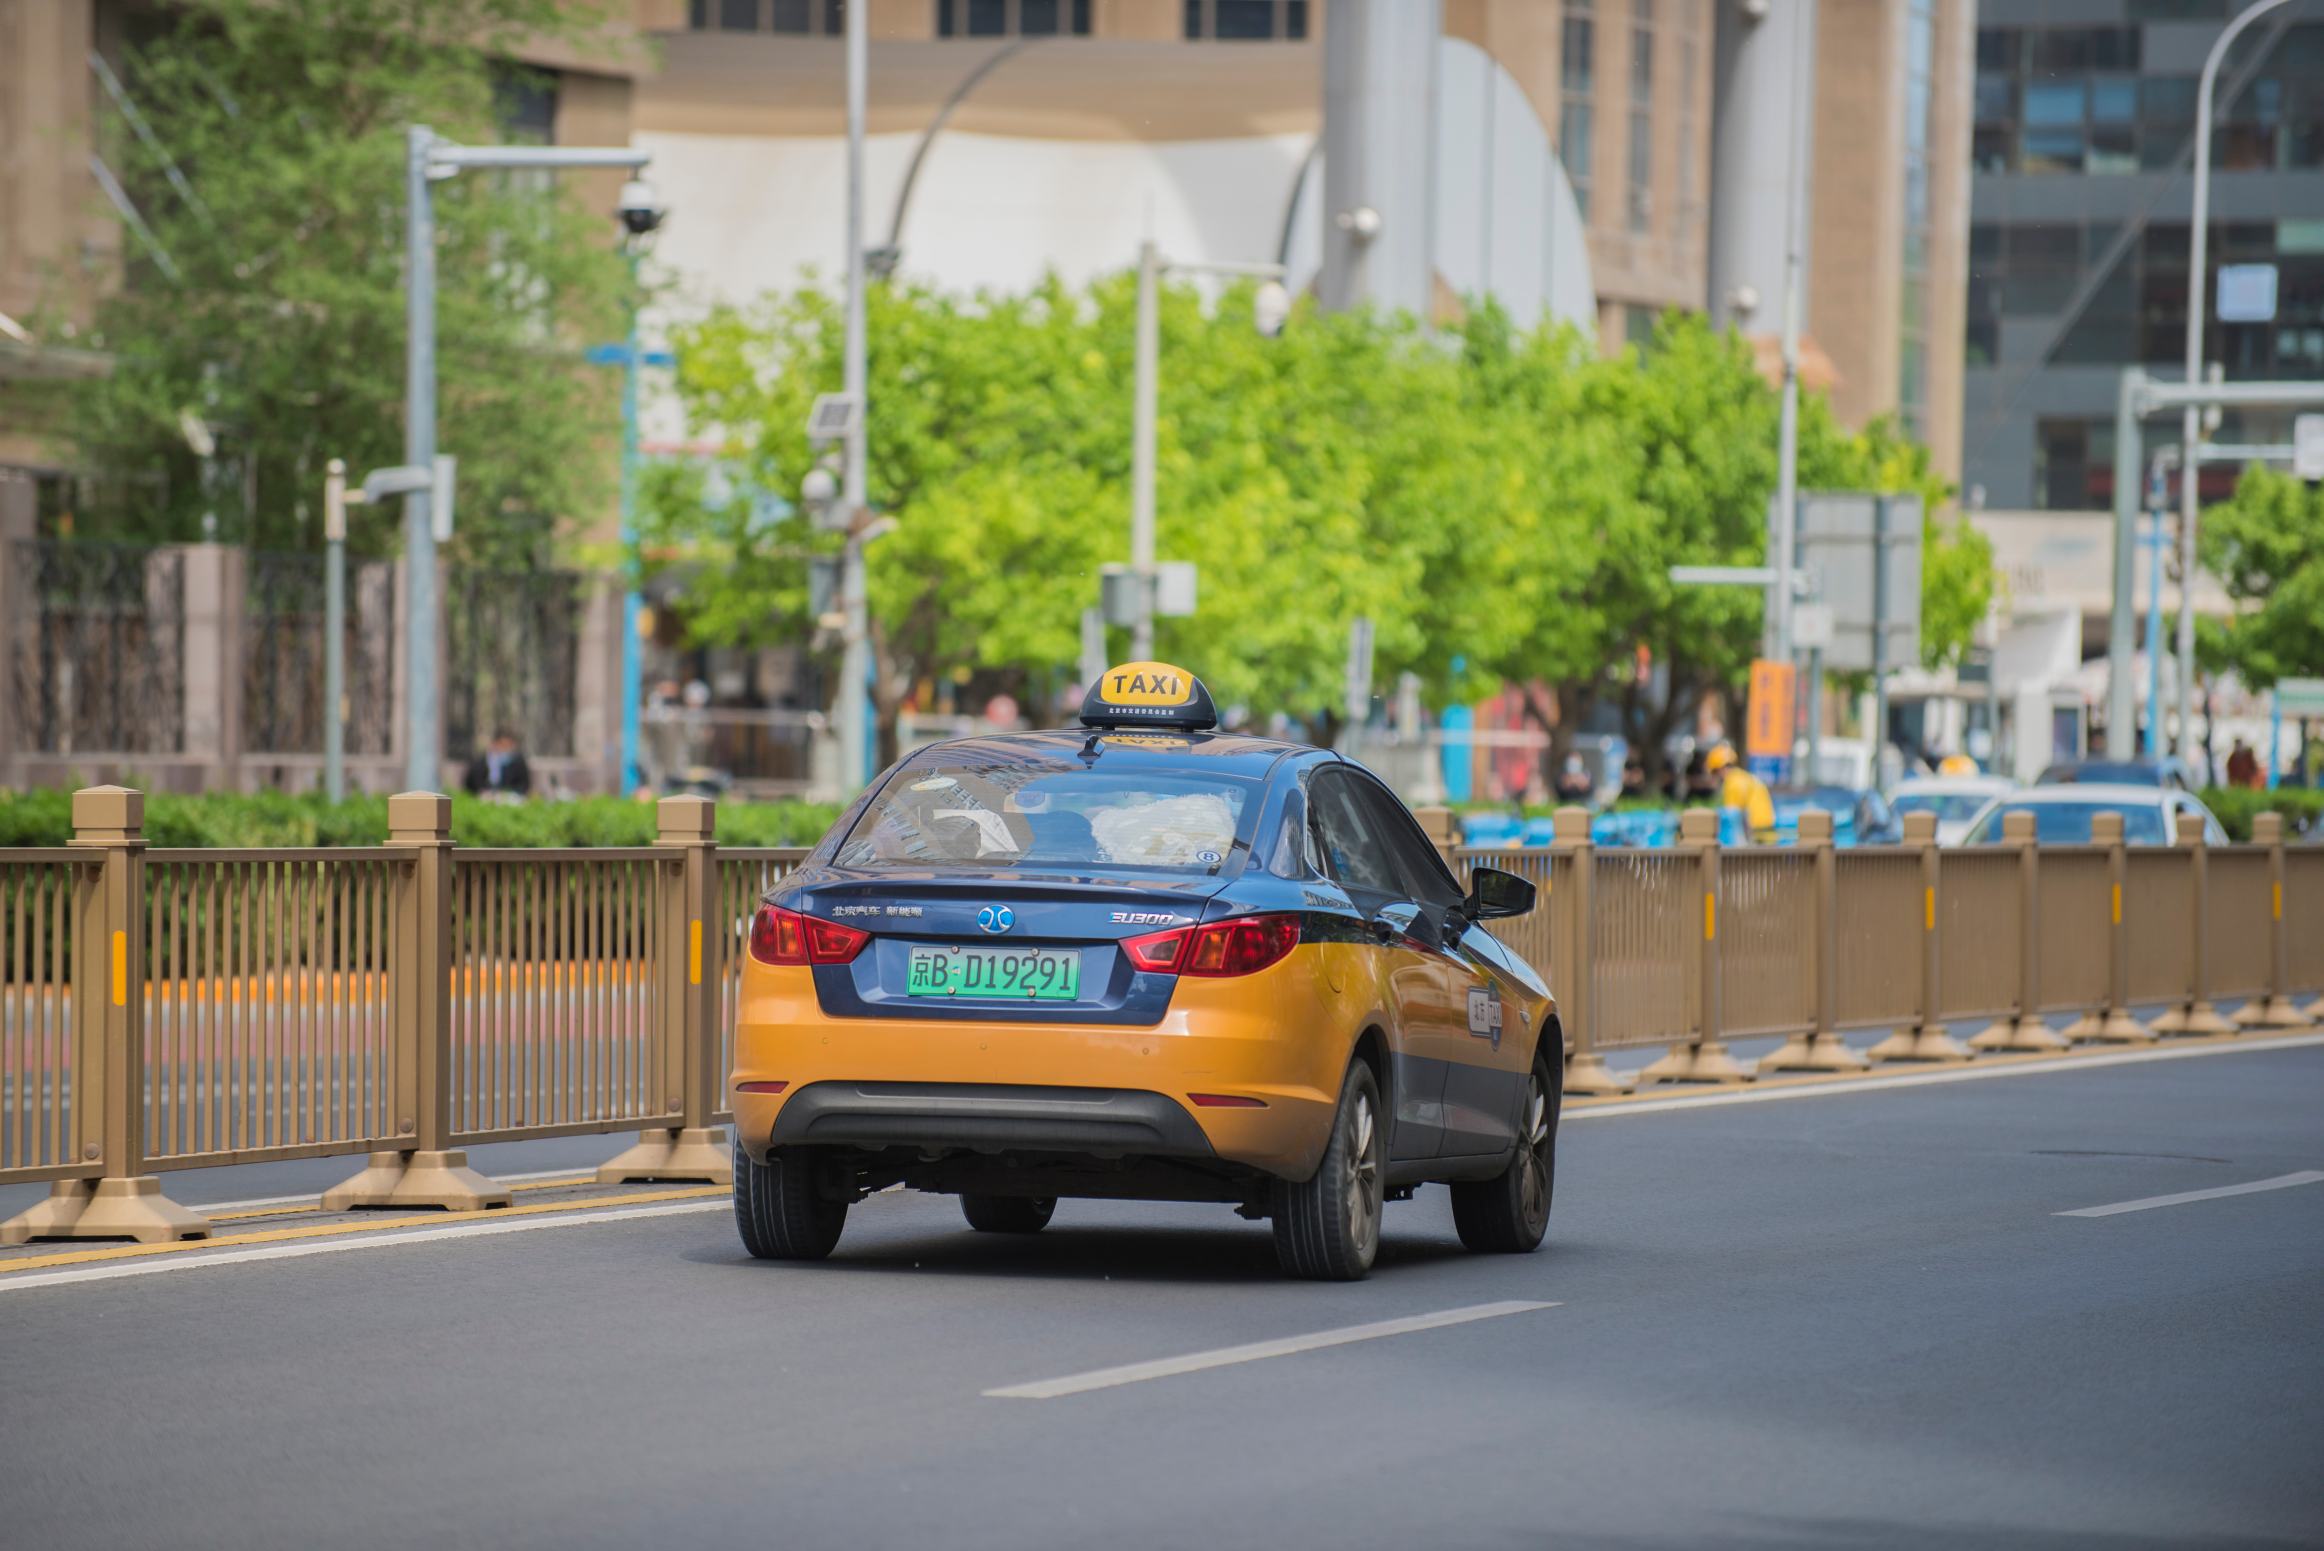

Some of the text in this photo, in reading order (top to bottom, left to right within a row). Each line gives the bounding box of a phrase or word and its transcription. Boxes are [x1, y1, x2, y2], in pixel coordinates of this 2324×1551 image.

[1113, 674, 1178, 696] TAXI
[1203, 852, 1214, 861] 8
[832, 905, 881, 917] 北京汽车
[1108, 912, 1174, 926] EU300
